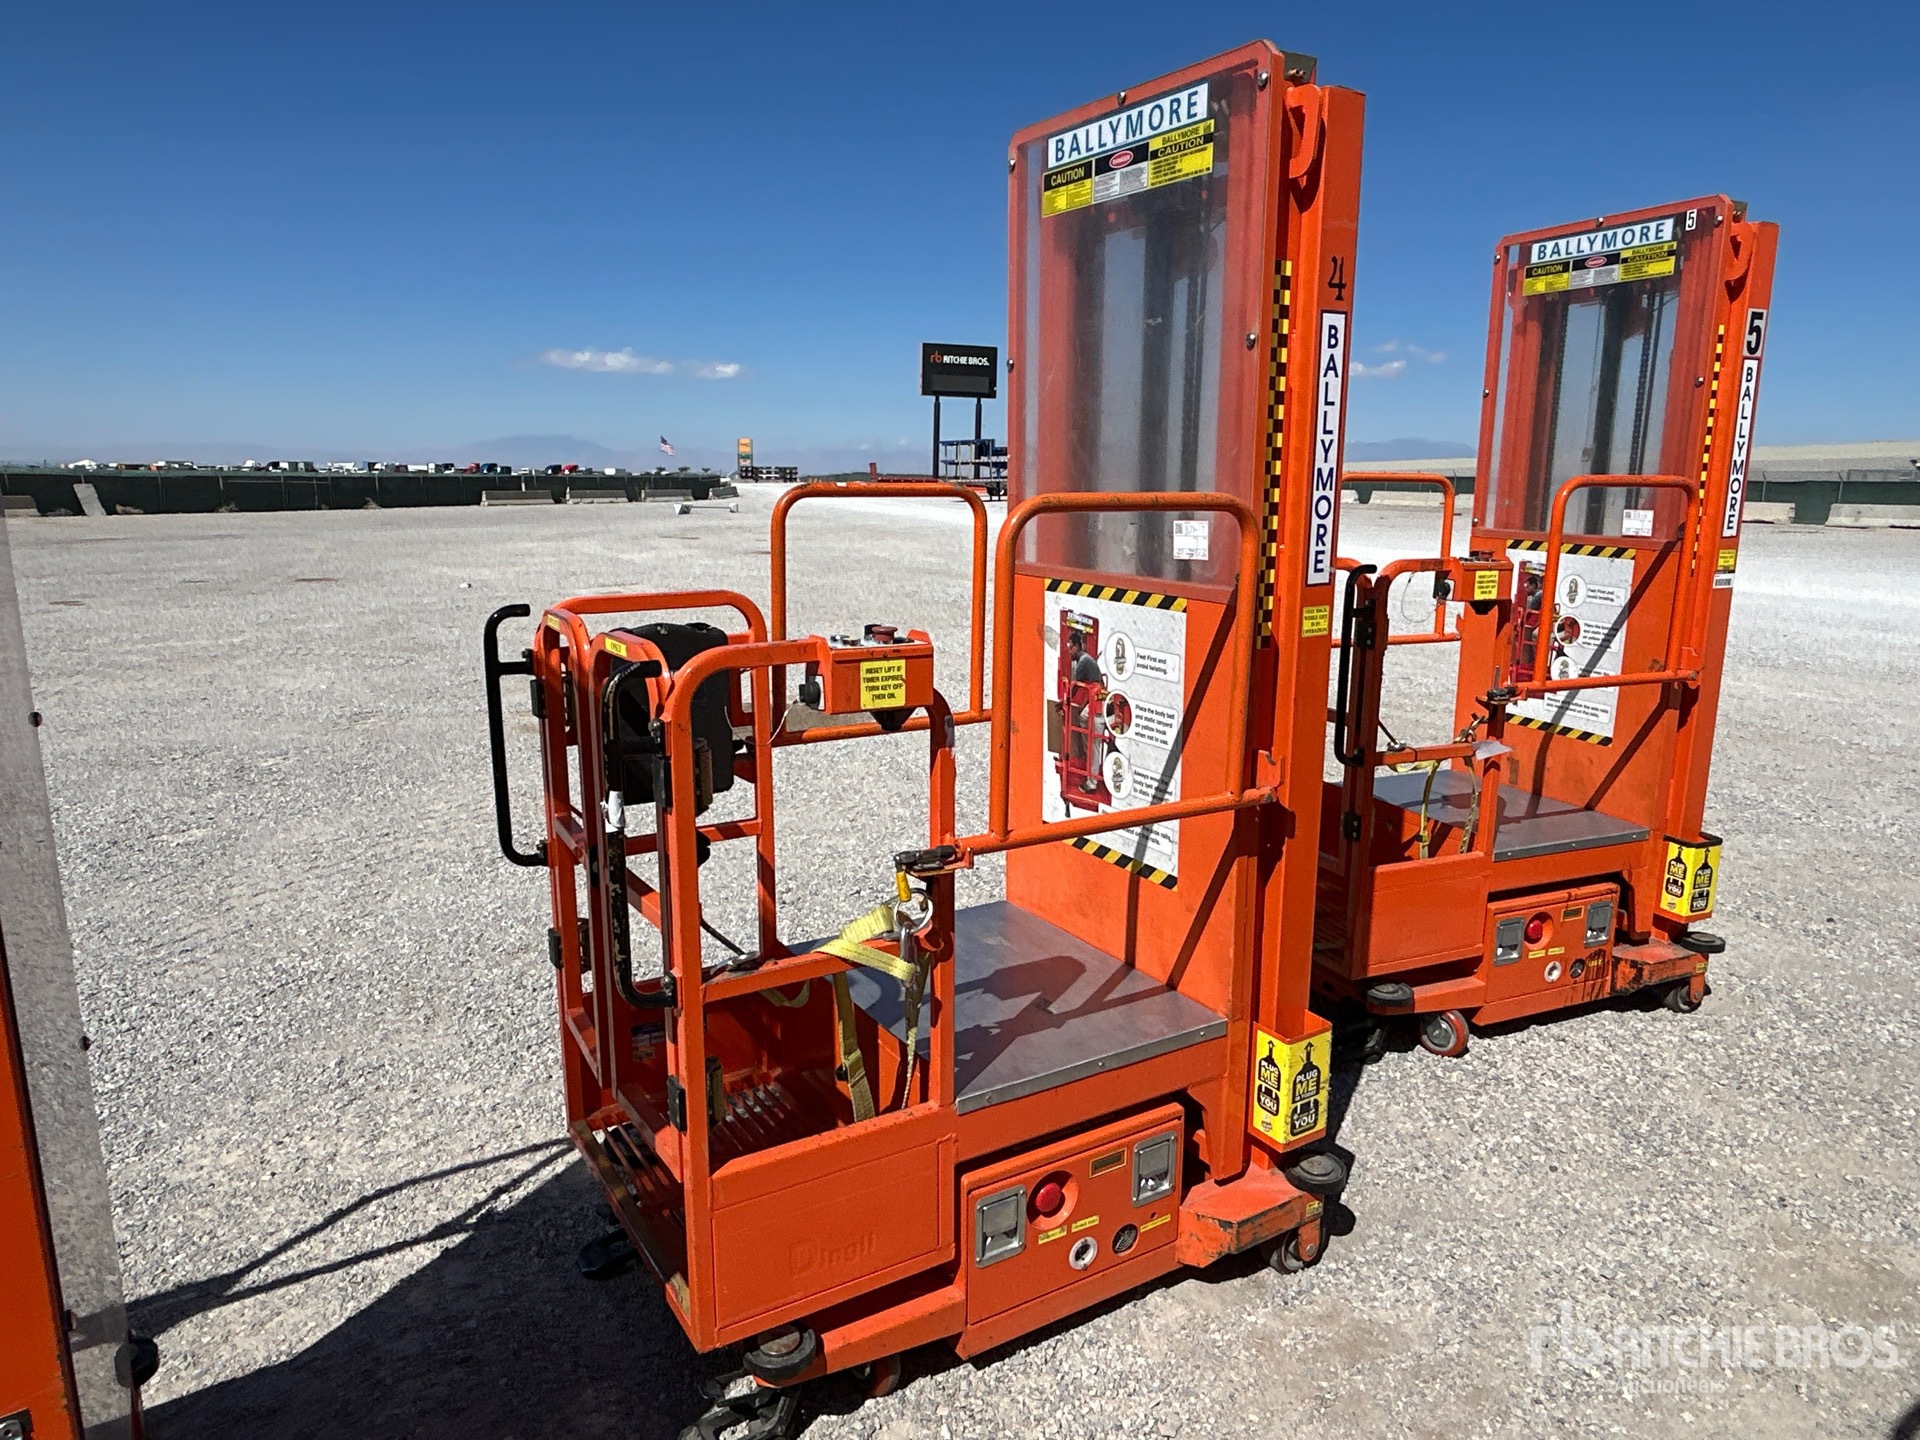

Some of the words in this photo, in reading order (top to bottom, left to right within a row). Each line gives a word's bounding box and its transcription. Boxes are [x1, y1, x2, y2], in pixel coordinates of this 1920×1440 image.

[1055, 90, 1199, 163] BALLYMORE
[1162, 126, 1200, 146] BALLYMORE
[1158, 136, 1204, 157] CAUTION
[1051, 166, 1085, 186] CAUTION
[1687, 211, 1695, 229] 5
[1538, 222, 1665, 261] BALLYMORE
[1628, 251, 1668, 262] CAUTION
[1326, 256, 1347, 301] 4
[1532, 264, 1563, 276] CAUTION
[1746, 310, 1763, 356] 5
[943, 355, 968, 364] RITCHIE
[968, 356, 990, 366] BROS.
[1313, 323, 1339, 574] BALLYMORE
[1727, 366, 1753, 530] BALLYMORE
[872, 693, 886, 701] THEN
[1670, 865, 1685, 877] ME
[1695, 874, 1710, 886] ME
[1667, 884, 1682, 896] YOU
[1692, 899, 1708, 909] YOU
[1261, 1059, 1279, 1075] PLUG
[1261, 1067, 1279, 1086] ME
[1295, 1068, 1318, 1084] PLUG
[1295, 1077, 1318, 1098] ME
[1260, 1094, 1278, 1110] YOU
[1293, 1112, 1316, 1128] YOU
